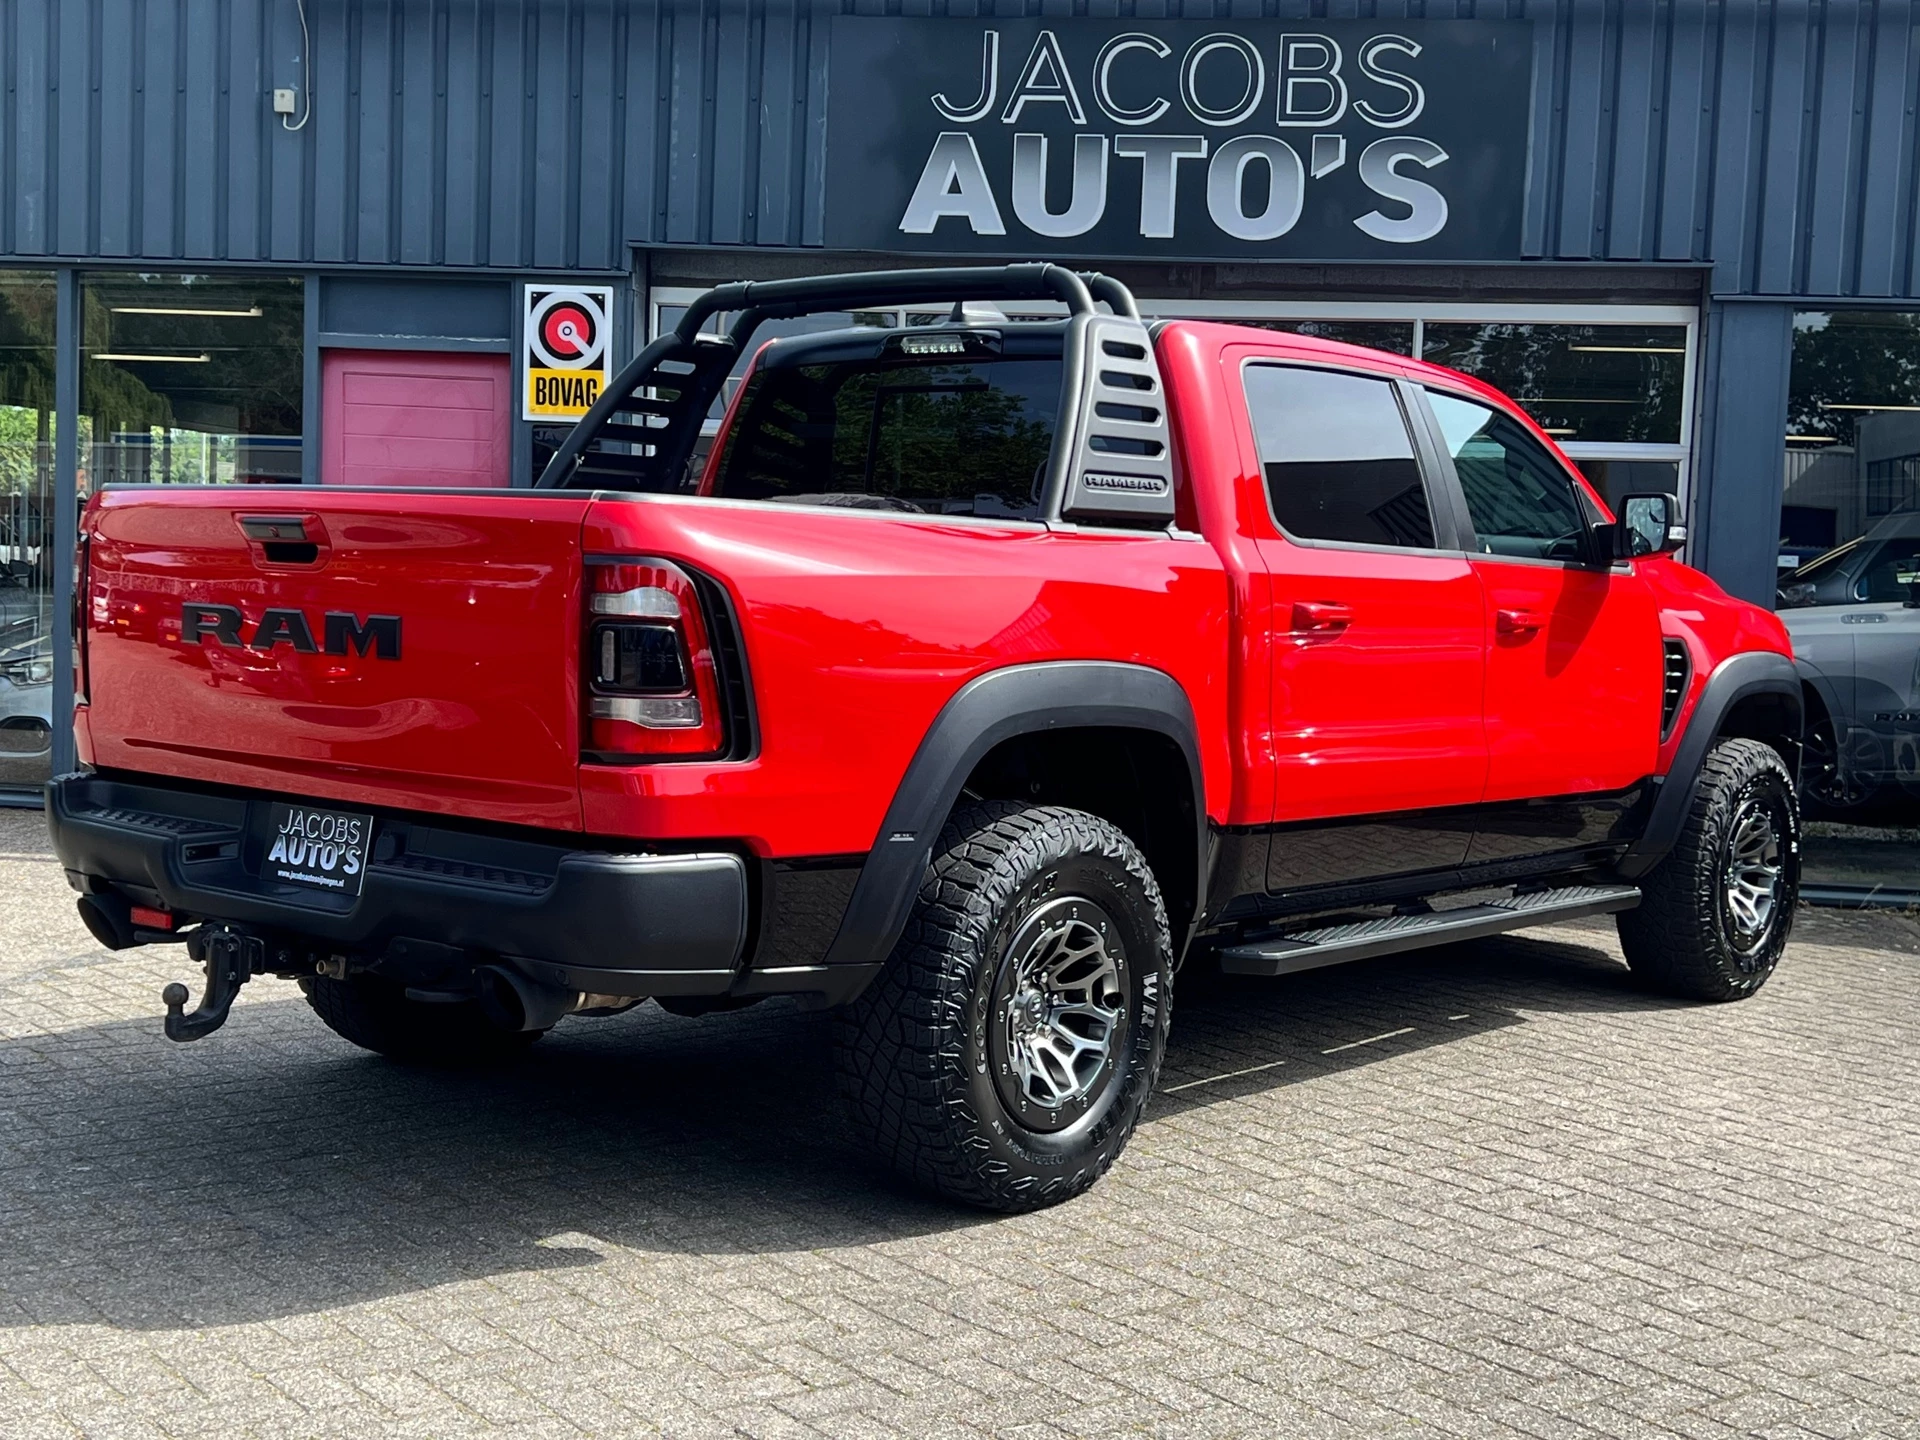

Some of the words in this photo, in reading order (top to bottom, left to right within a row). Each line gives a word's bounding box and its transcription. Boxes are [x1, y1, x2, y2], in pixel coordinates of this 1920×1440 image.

[930, 30, 1426, 128] JACOBS
[898, 131, 1450, 244] AUTO'S
[535, 376, 598, 408] BOVAG
[181, 601, 402, 660] RAM
[278, 808, 362, 845] JACOBS
[267, 834, 362, 875] AUTO'S
